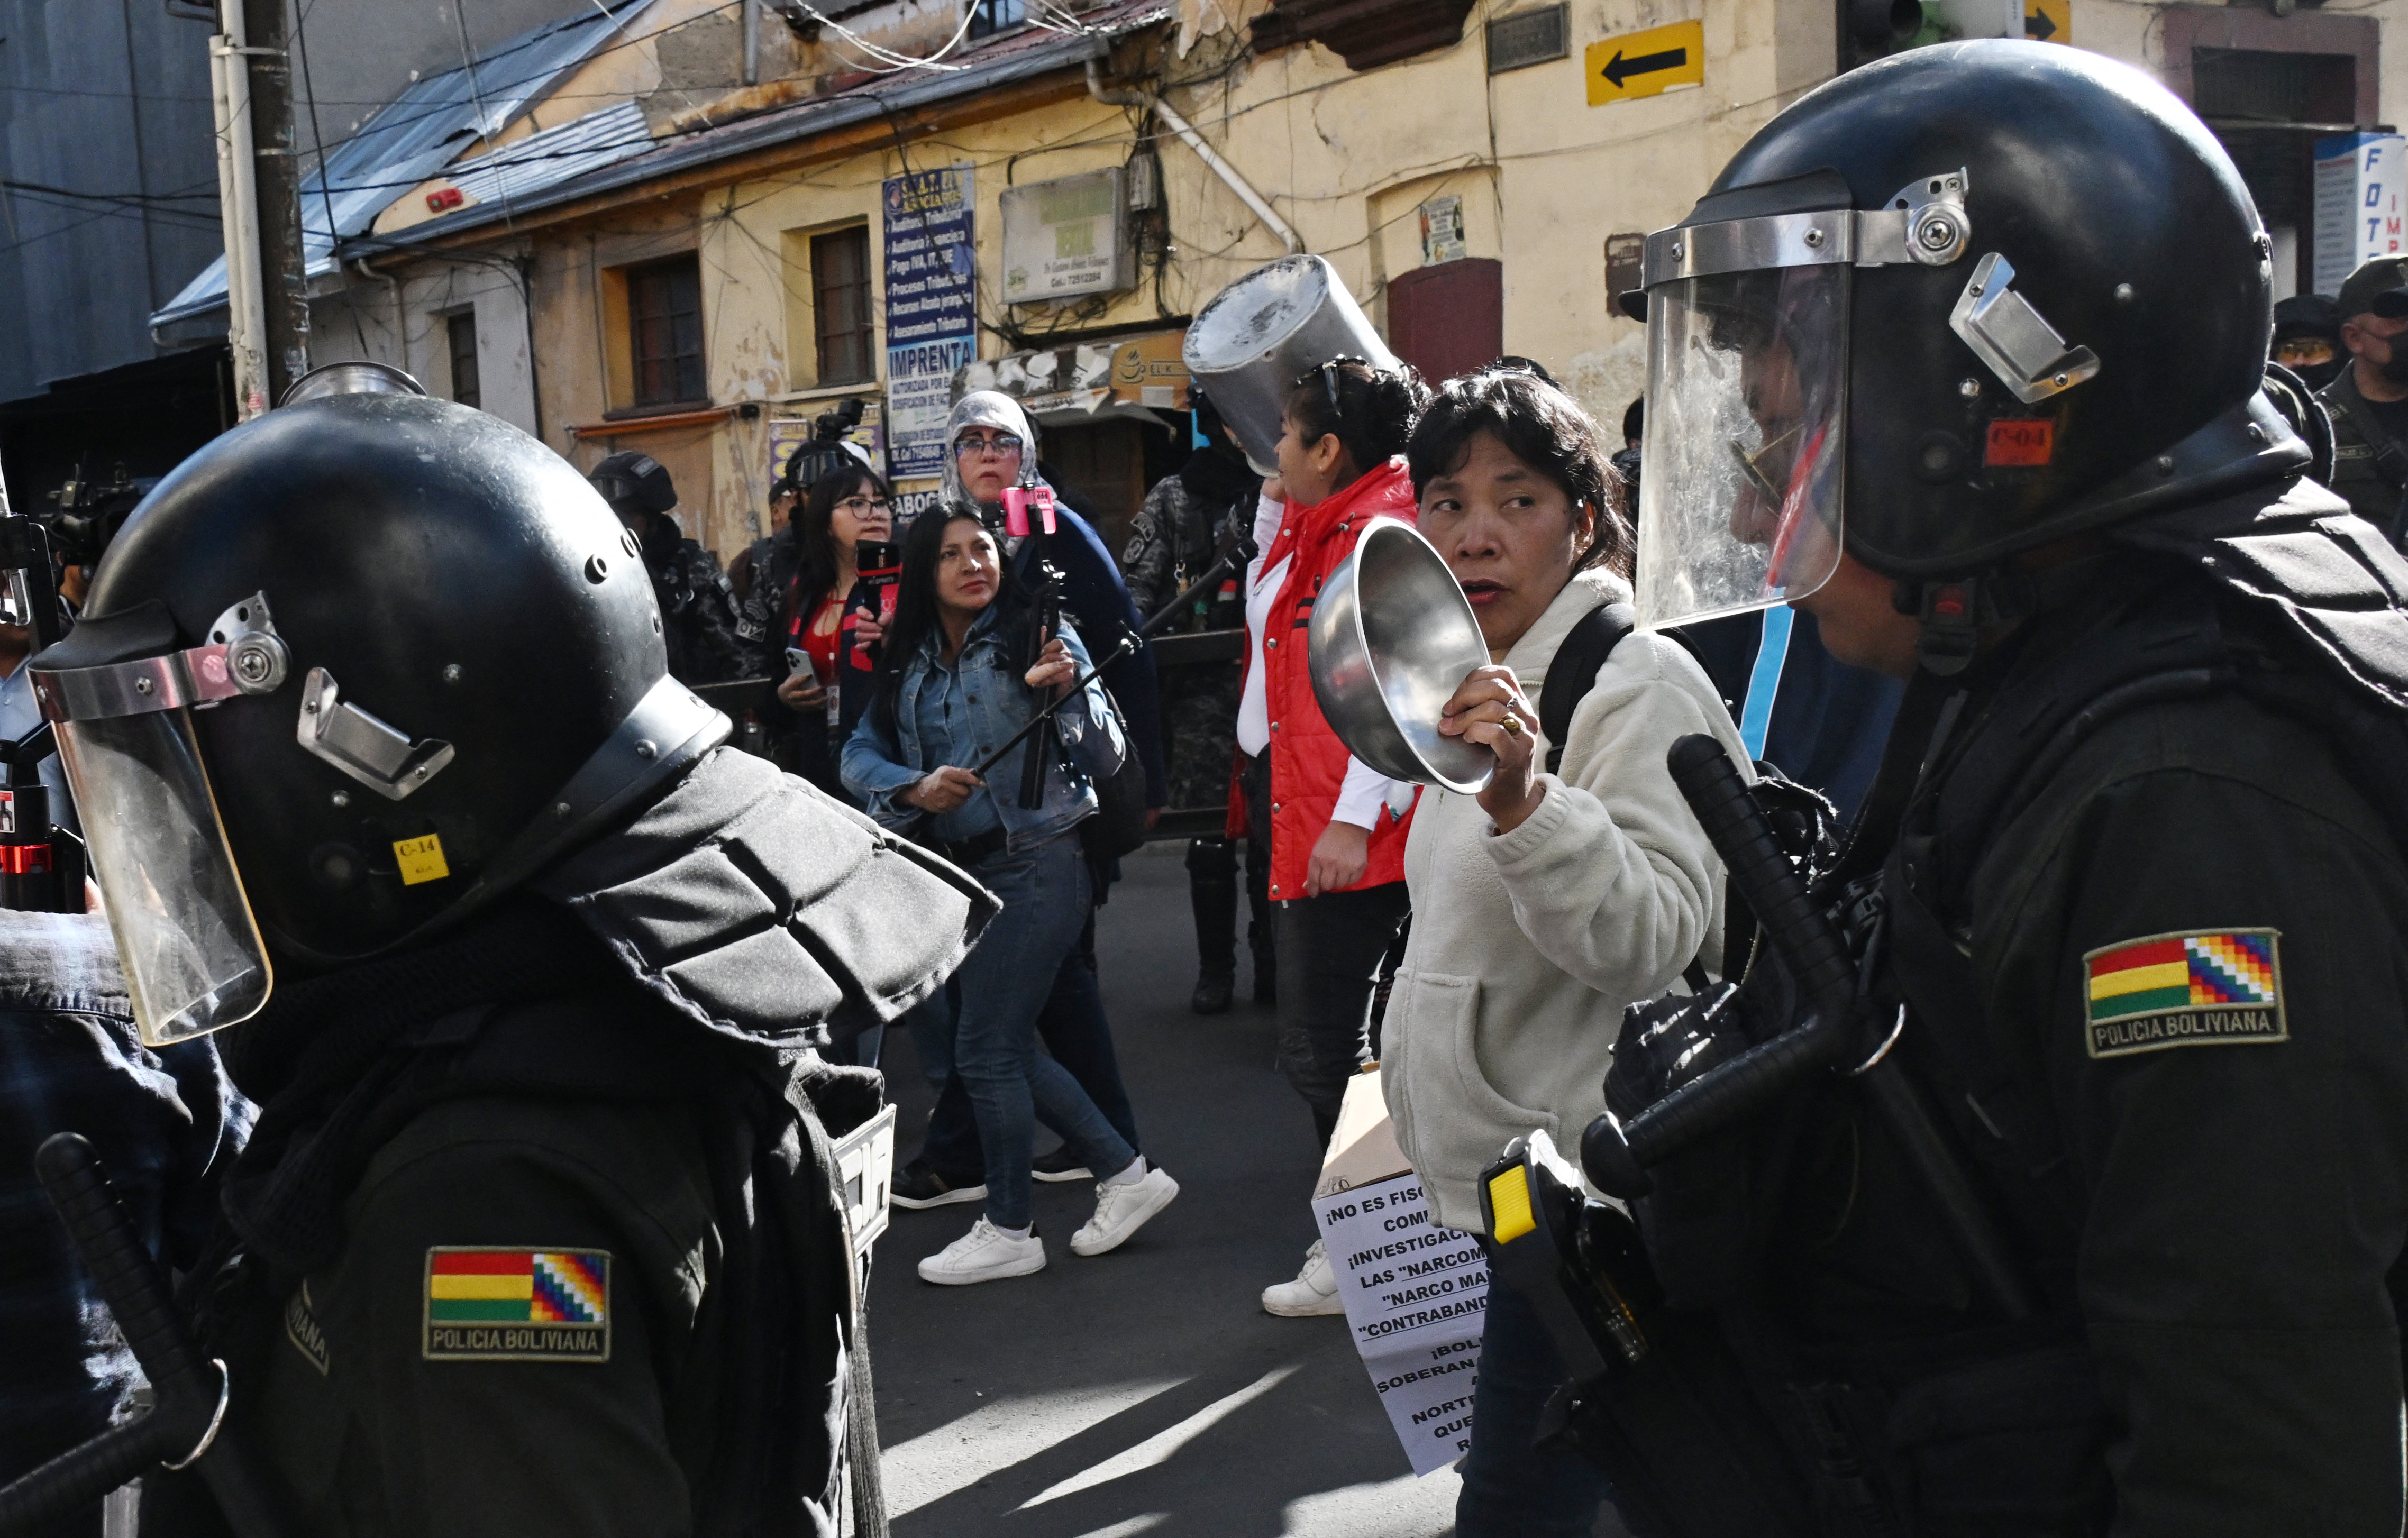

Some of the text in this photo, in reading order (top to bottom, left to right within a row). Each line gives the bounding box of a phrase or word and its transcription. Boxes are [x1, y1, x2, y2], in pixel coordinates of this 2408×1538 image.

[890, 341, 971, 378] IMPRENTA
[2096, 1011, 2274, 1047] POLICIA BOLIVIANA
[1326, 1204, 1356, 1226] ¡NO
[1362, 1197, 1384, 1213] ES
[1361, 1270, 1395, 1288] LAS
[1382, 1280, 1454, 1306] "NARCO
[433, 1329, 598, 1350] POLICIA BOLIVIANA
